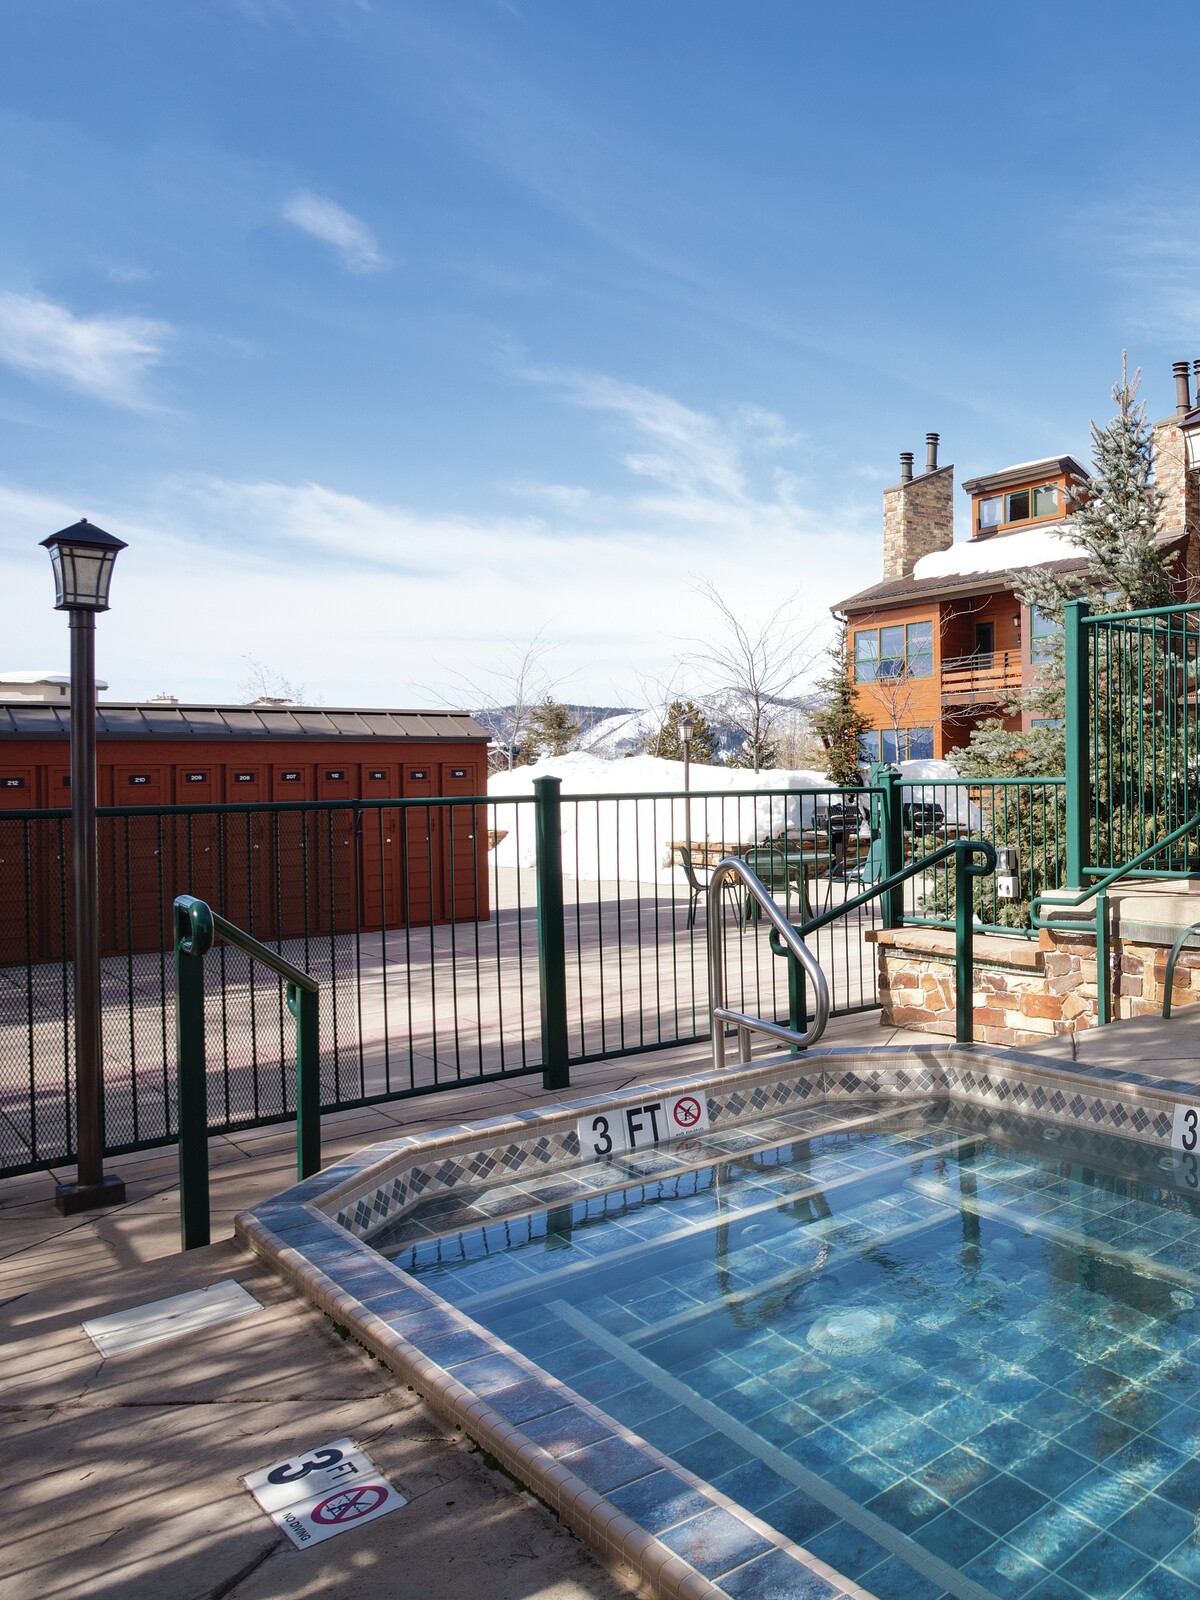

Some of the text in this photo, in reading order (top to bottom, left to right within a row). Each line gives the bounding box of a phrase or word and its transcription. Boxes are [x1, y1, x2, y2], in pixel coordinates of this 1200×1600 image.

[593, 1103, 661, 1155] 3 FT
[1182, 1109, 1198, 1150] 3
[268, 1449, 359, 1484] 3 FT
[282, 1512, 311, 1541] NO DIVING
